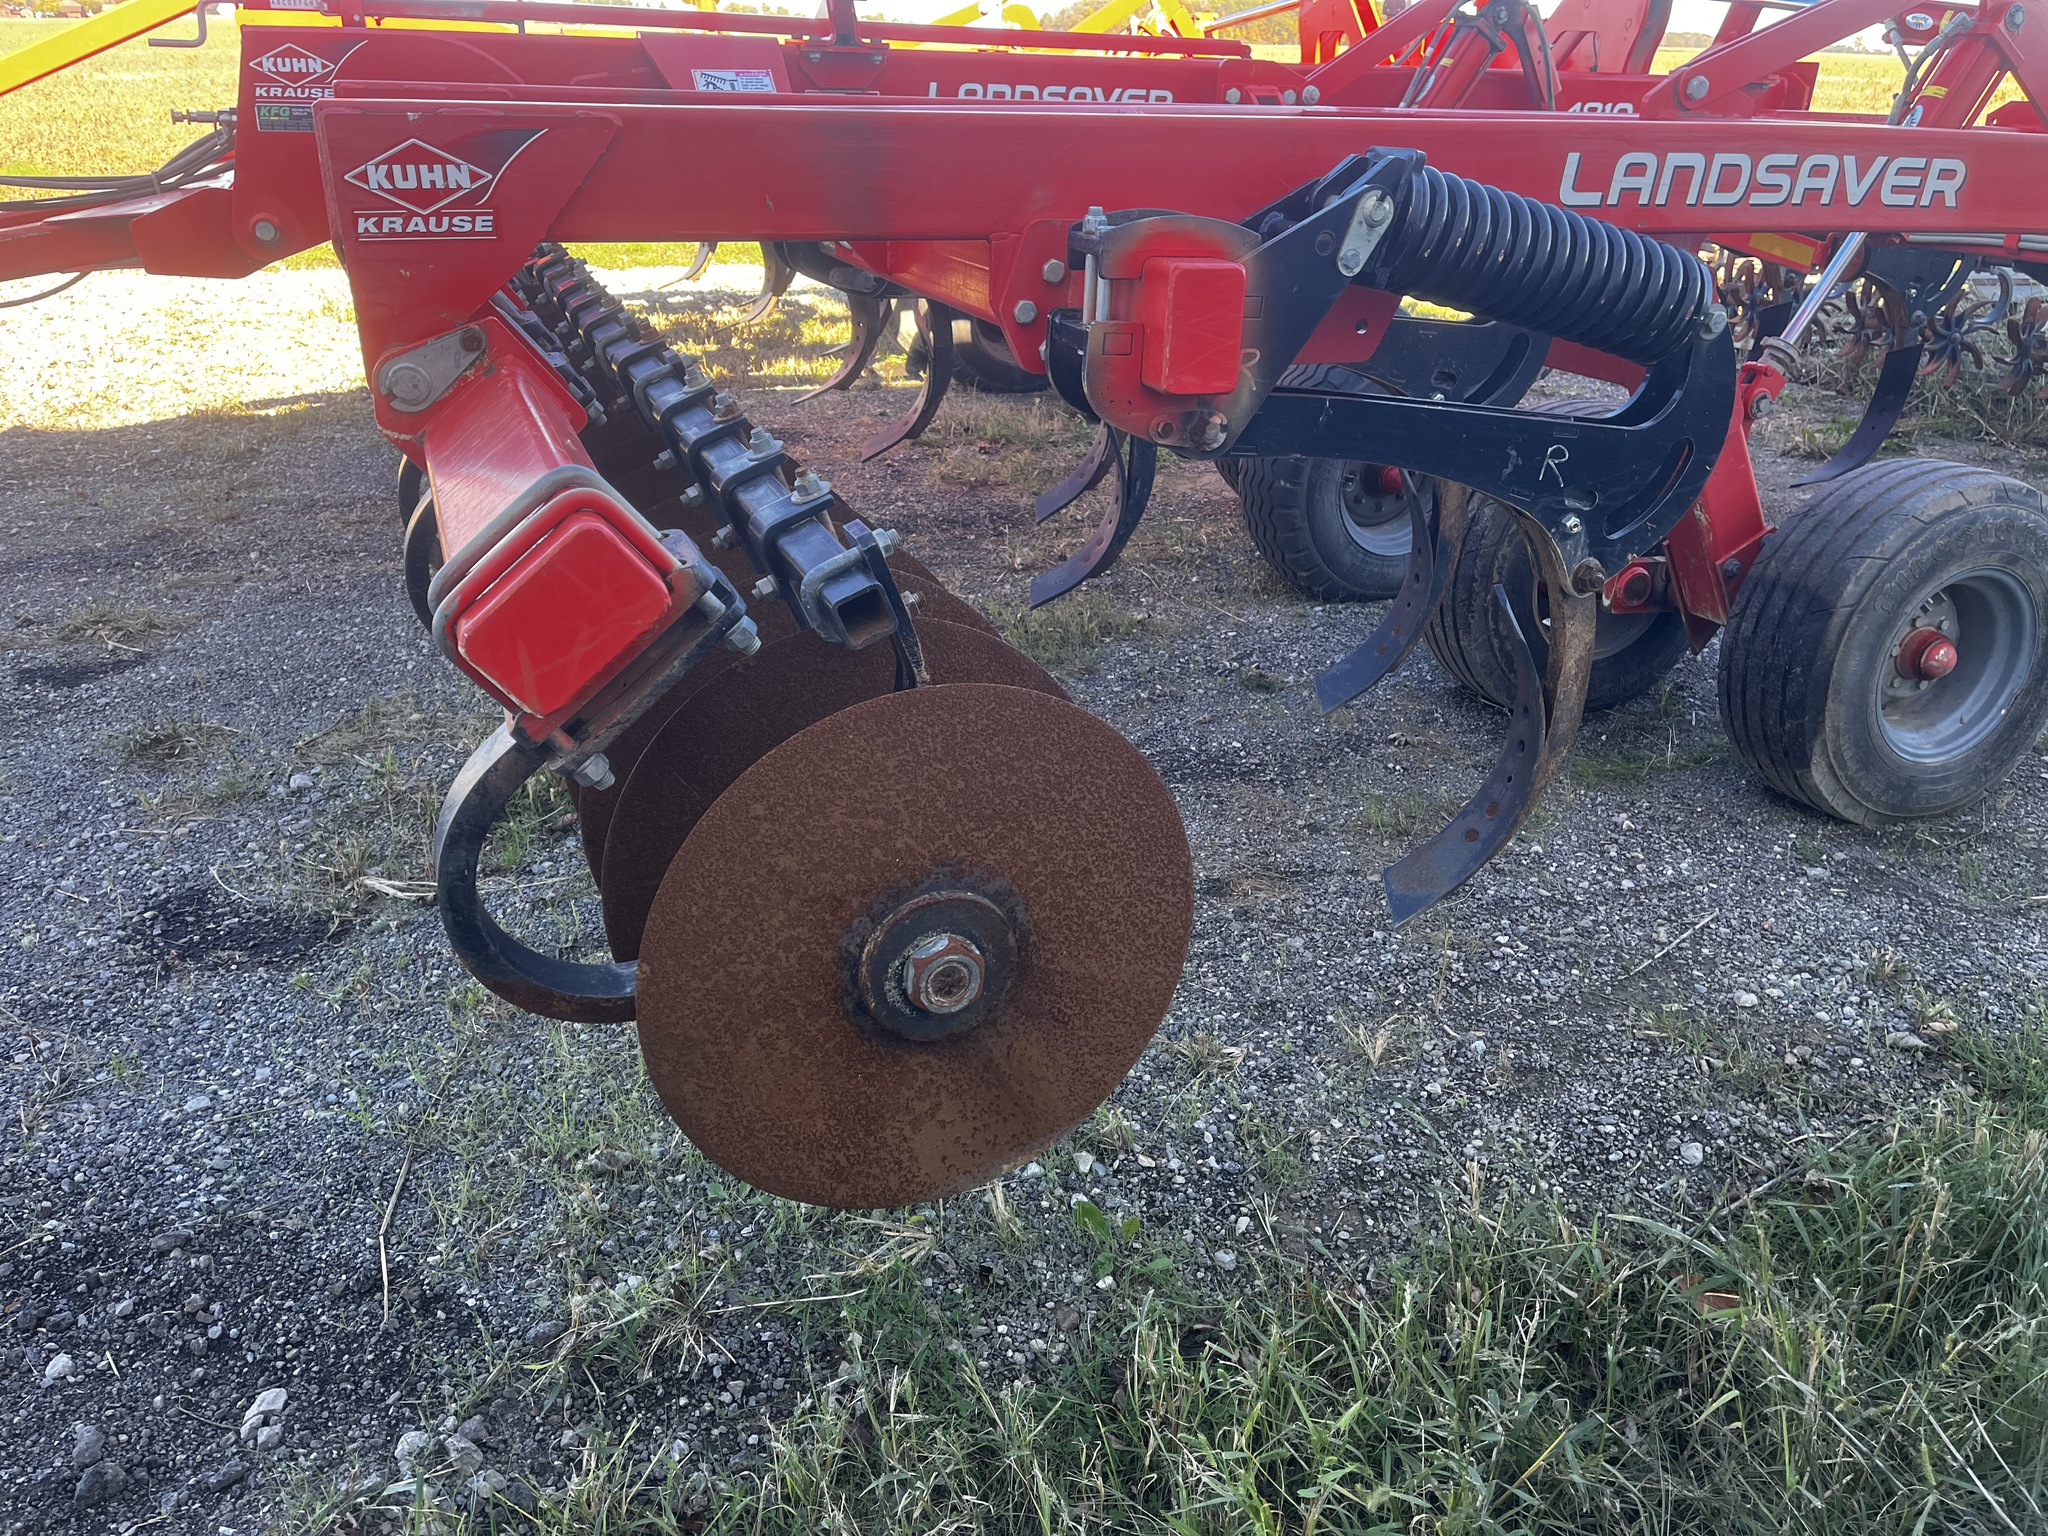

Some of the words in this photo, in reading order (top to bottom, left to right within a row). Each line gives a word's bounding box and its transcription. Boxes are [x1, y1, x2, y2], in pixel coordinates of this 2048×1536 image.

[261, 57, 323, 73] KUHN
[255, 87, 335, 98] KRAUSE
[260, 106, 291, 117] KFG
[365, 164, 472, 190] KUHN
[1559, 151, 1968, 208] LANDSAVER
[357, 215, 494, 234] KRAUSE
[1538, 444, 1569, 488] R
